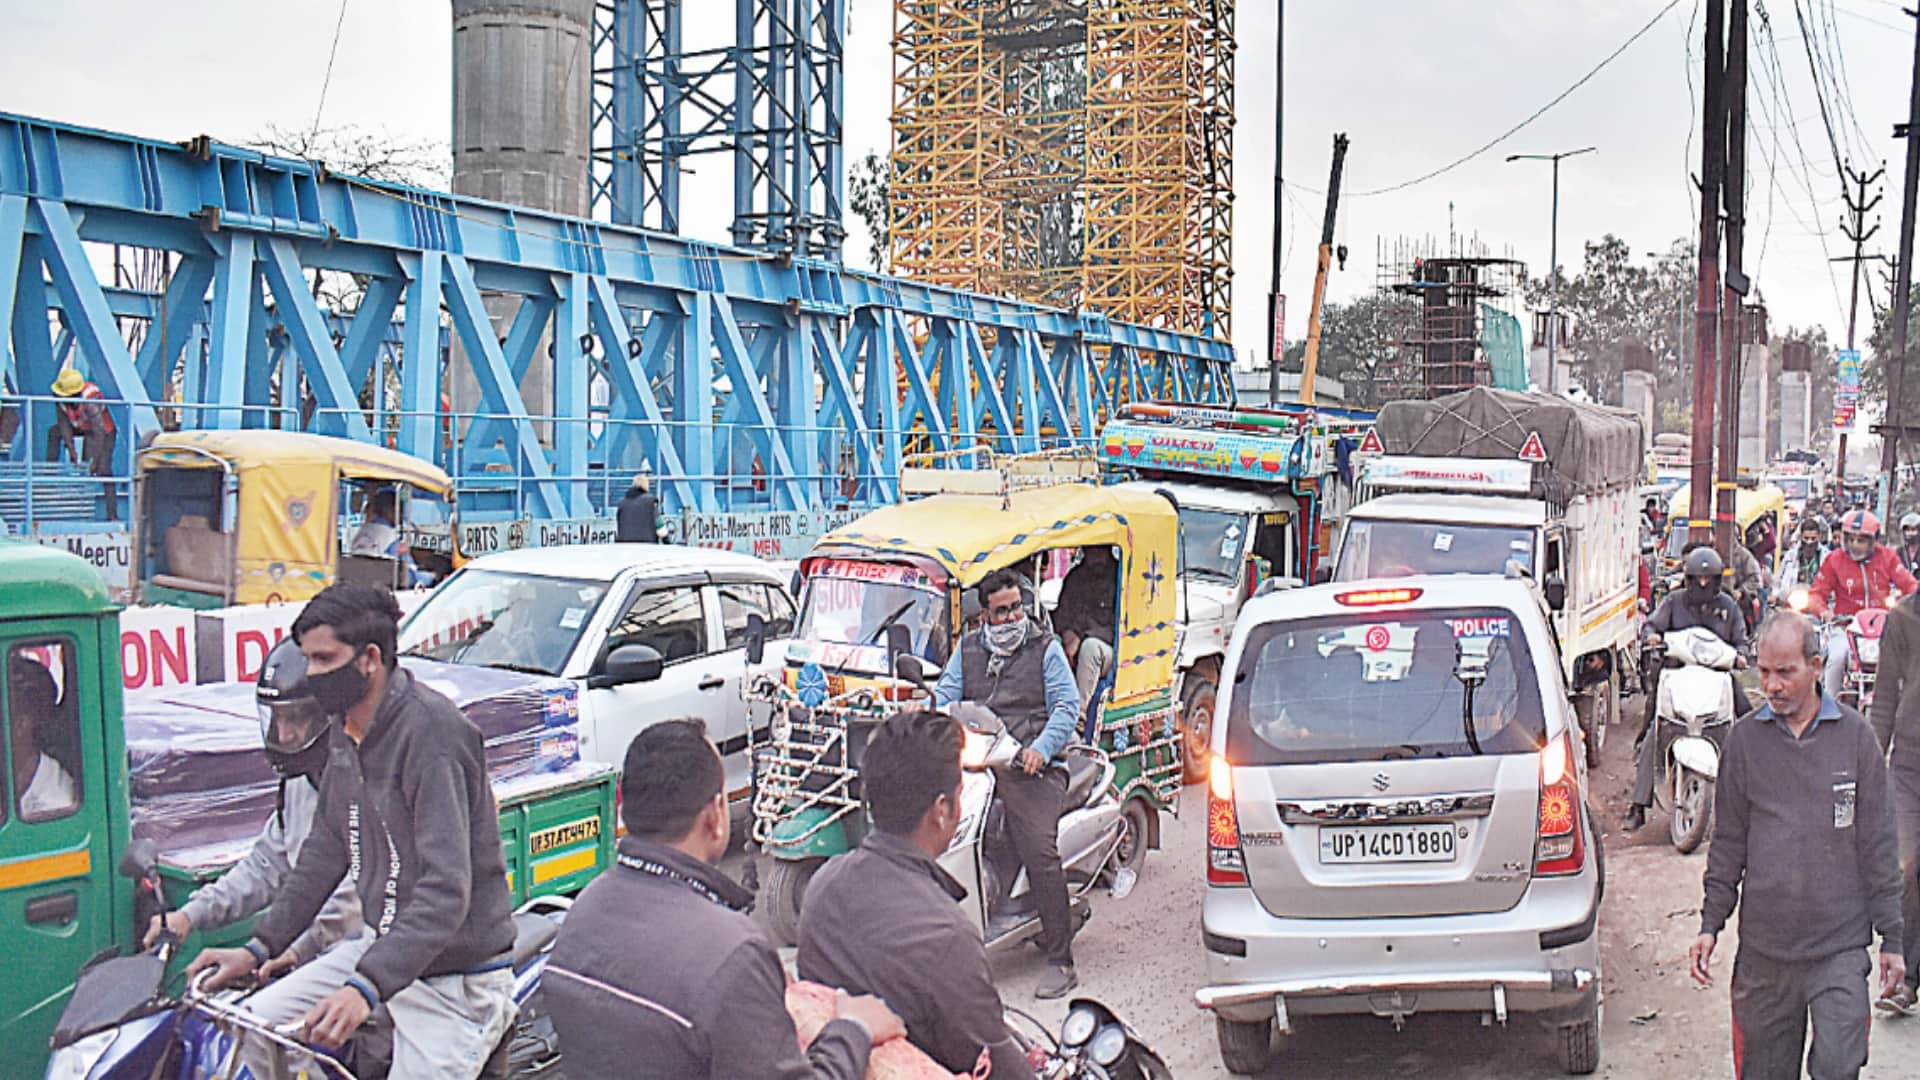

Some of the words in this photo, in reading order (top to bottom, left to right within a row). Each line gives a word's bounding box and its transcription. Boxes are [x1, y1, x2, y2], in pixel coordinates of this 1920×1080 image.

[1453, 618, 1510, 637] POLICE
[349, 803, 360, 828] THE
[1332, 831, 1453, 858] UP14CD1880
